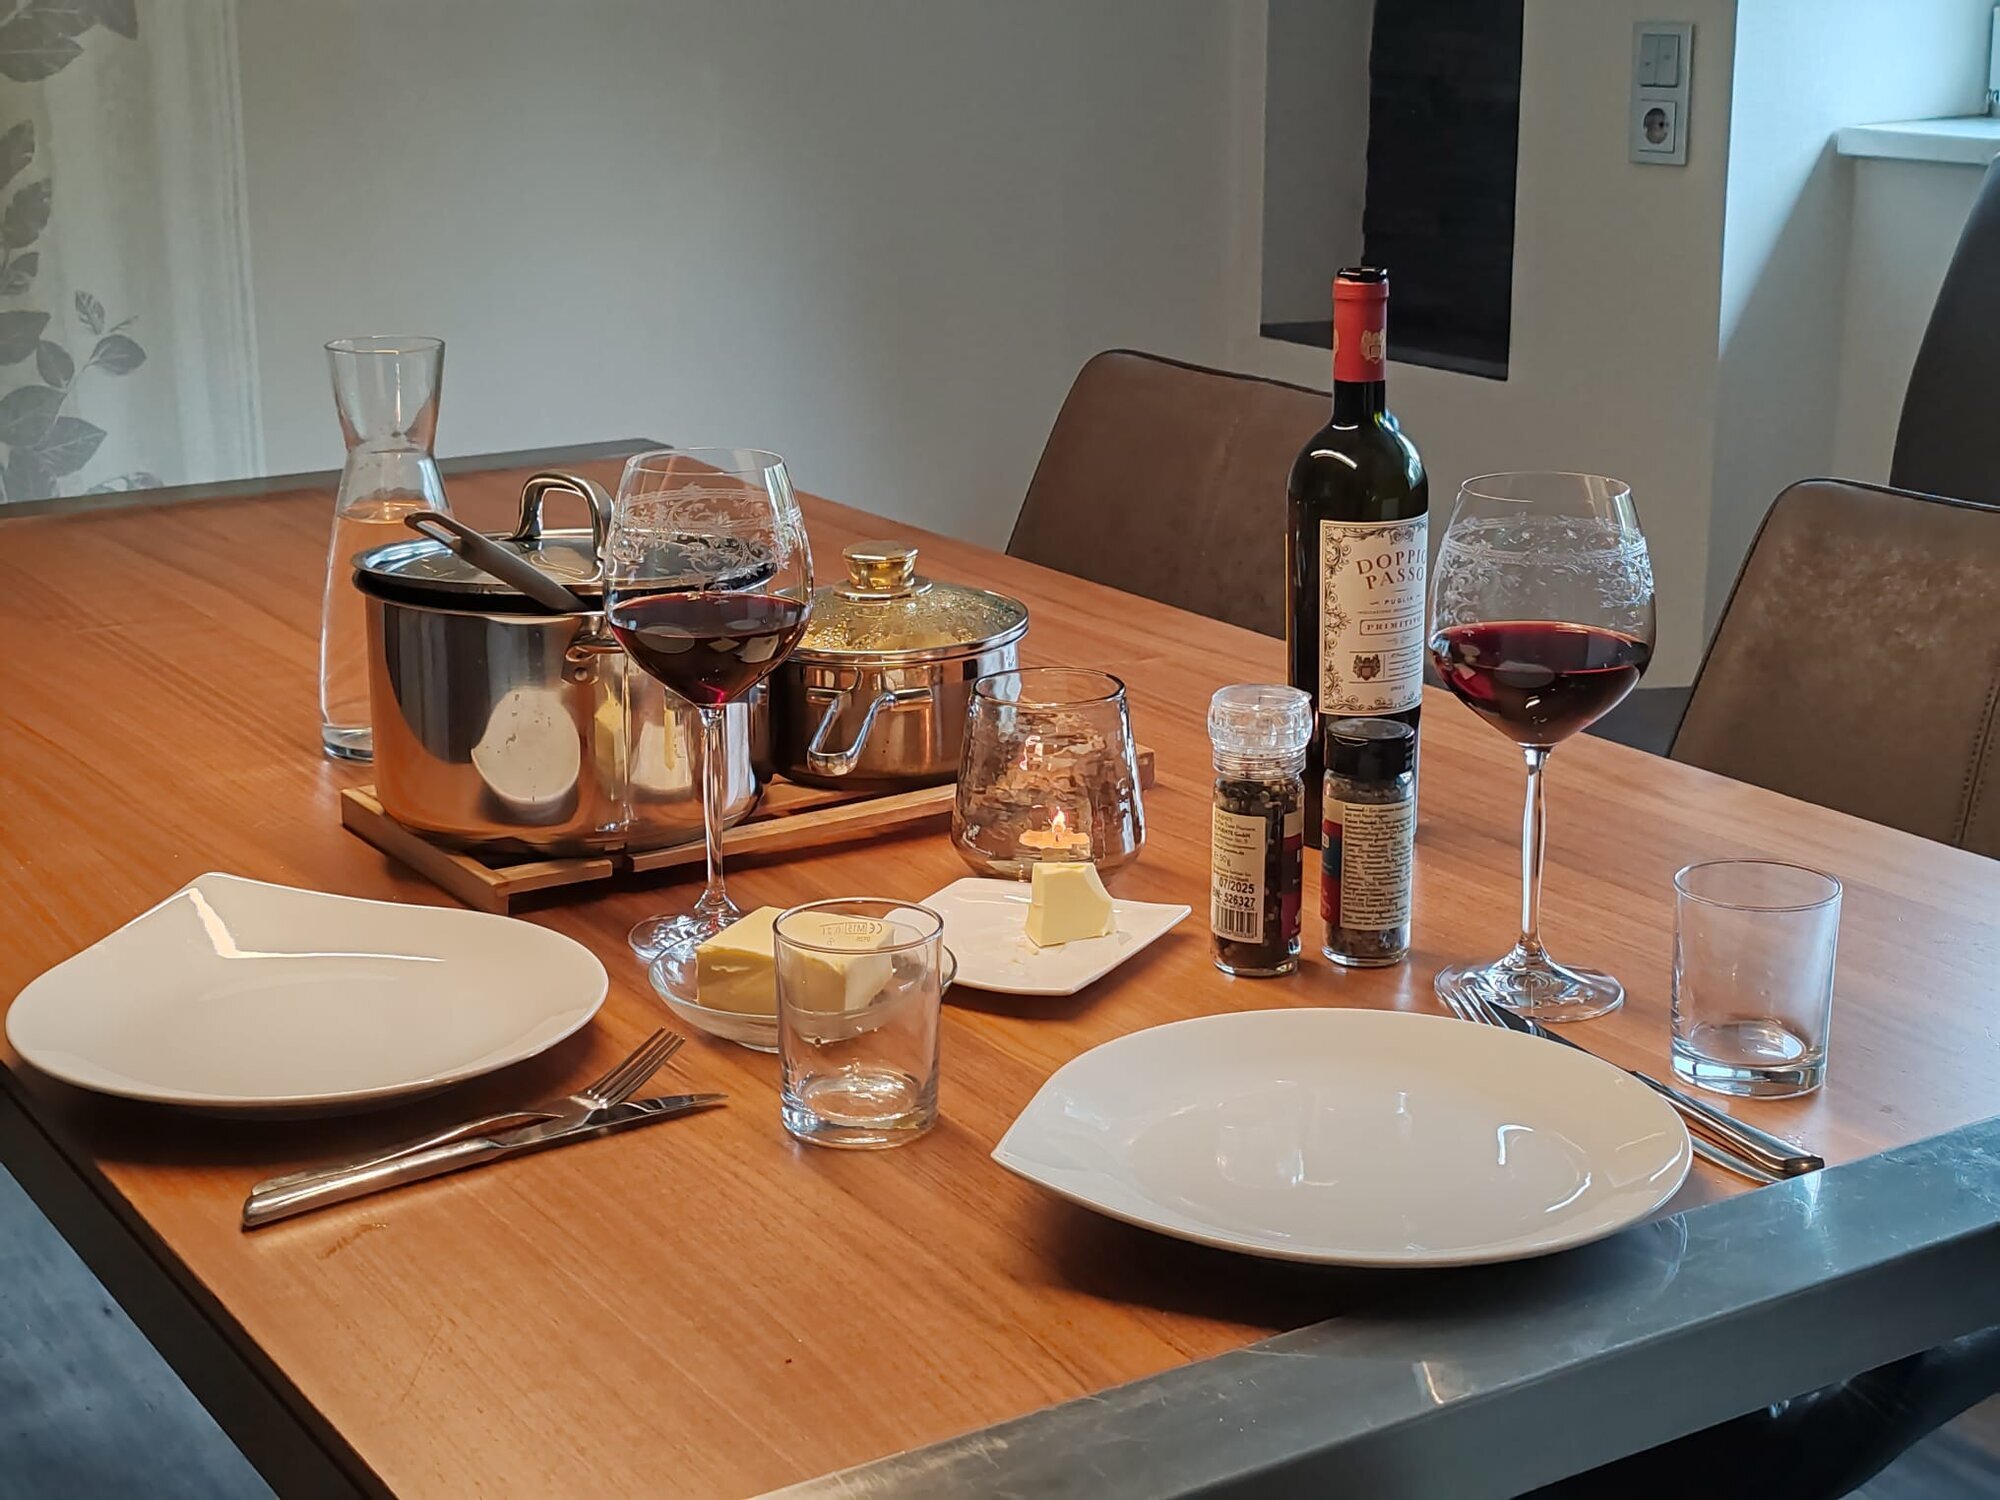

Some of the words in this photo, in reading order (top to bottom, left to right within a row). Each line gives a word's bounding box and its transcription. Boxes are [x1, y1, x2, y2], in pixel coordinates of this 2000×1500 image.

[1365, 566, 1424, 590] PASSO
[1219, 876, 1255, 895] 07/2025
[1224, 892, 1256, 908] 526327
